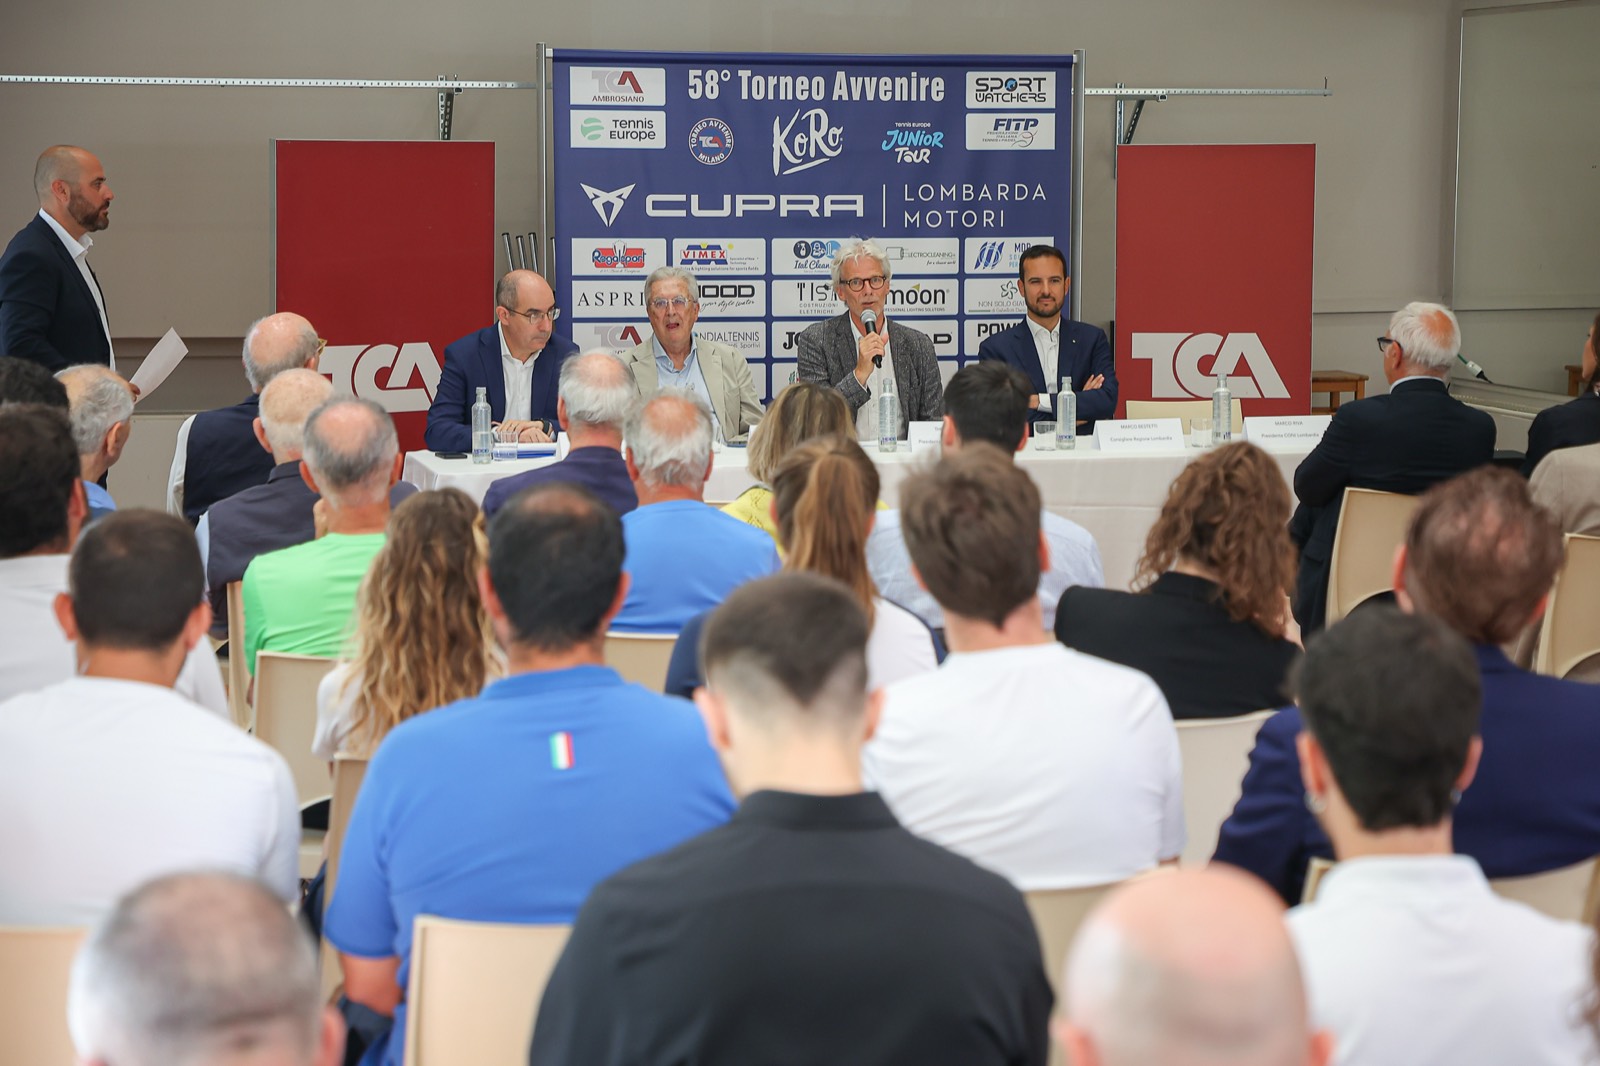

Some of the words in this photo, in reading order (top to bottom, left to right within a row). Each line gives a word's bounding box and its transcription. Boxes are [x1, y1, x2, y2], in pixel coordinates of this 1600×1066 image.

[591, 71, 644, 94] TCA
[688, 69, 732, 101] 58°
[738, 69, 825, 101] Torneo
[832, 71, 945, 102] Avvenire
[975, 77, 1046, 92] SPORT
[592, 95, 645, 103] AMBROSIANO
[975, 93, 1046, 104] WATCHERS
[612, 117, 654, 129] Tennis
[993, 118, 1039, 131] FITP
[609, 130, 656, 143] Europe
[690, 121, 708, 149] TORNEO
[708, 120, 733, 149] AVVENIRE
[699, 136, 723, 148] TCA
[698, 153, 725, 163] MILANO
[645, 194, 864, 218] CUPRA
[904, 183, 1047, 201] LOMBARDA
[904, 210, 1004, 228] MOTORI
[682, 250, 725, 259] VIMEX
[698, 285, 755, 298] OOD
[577, 291, 643, 307] ASPRI
[699, 331, 760, 342] NDIALTENNIS
[1131, 332, 1291, 399] TCA
[318, 342, 443, 414] TCA
